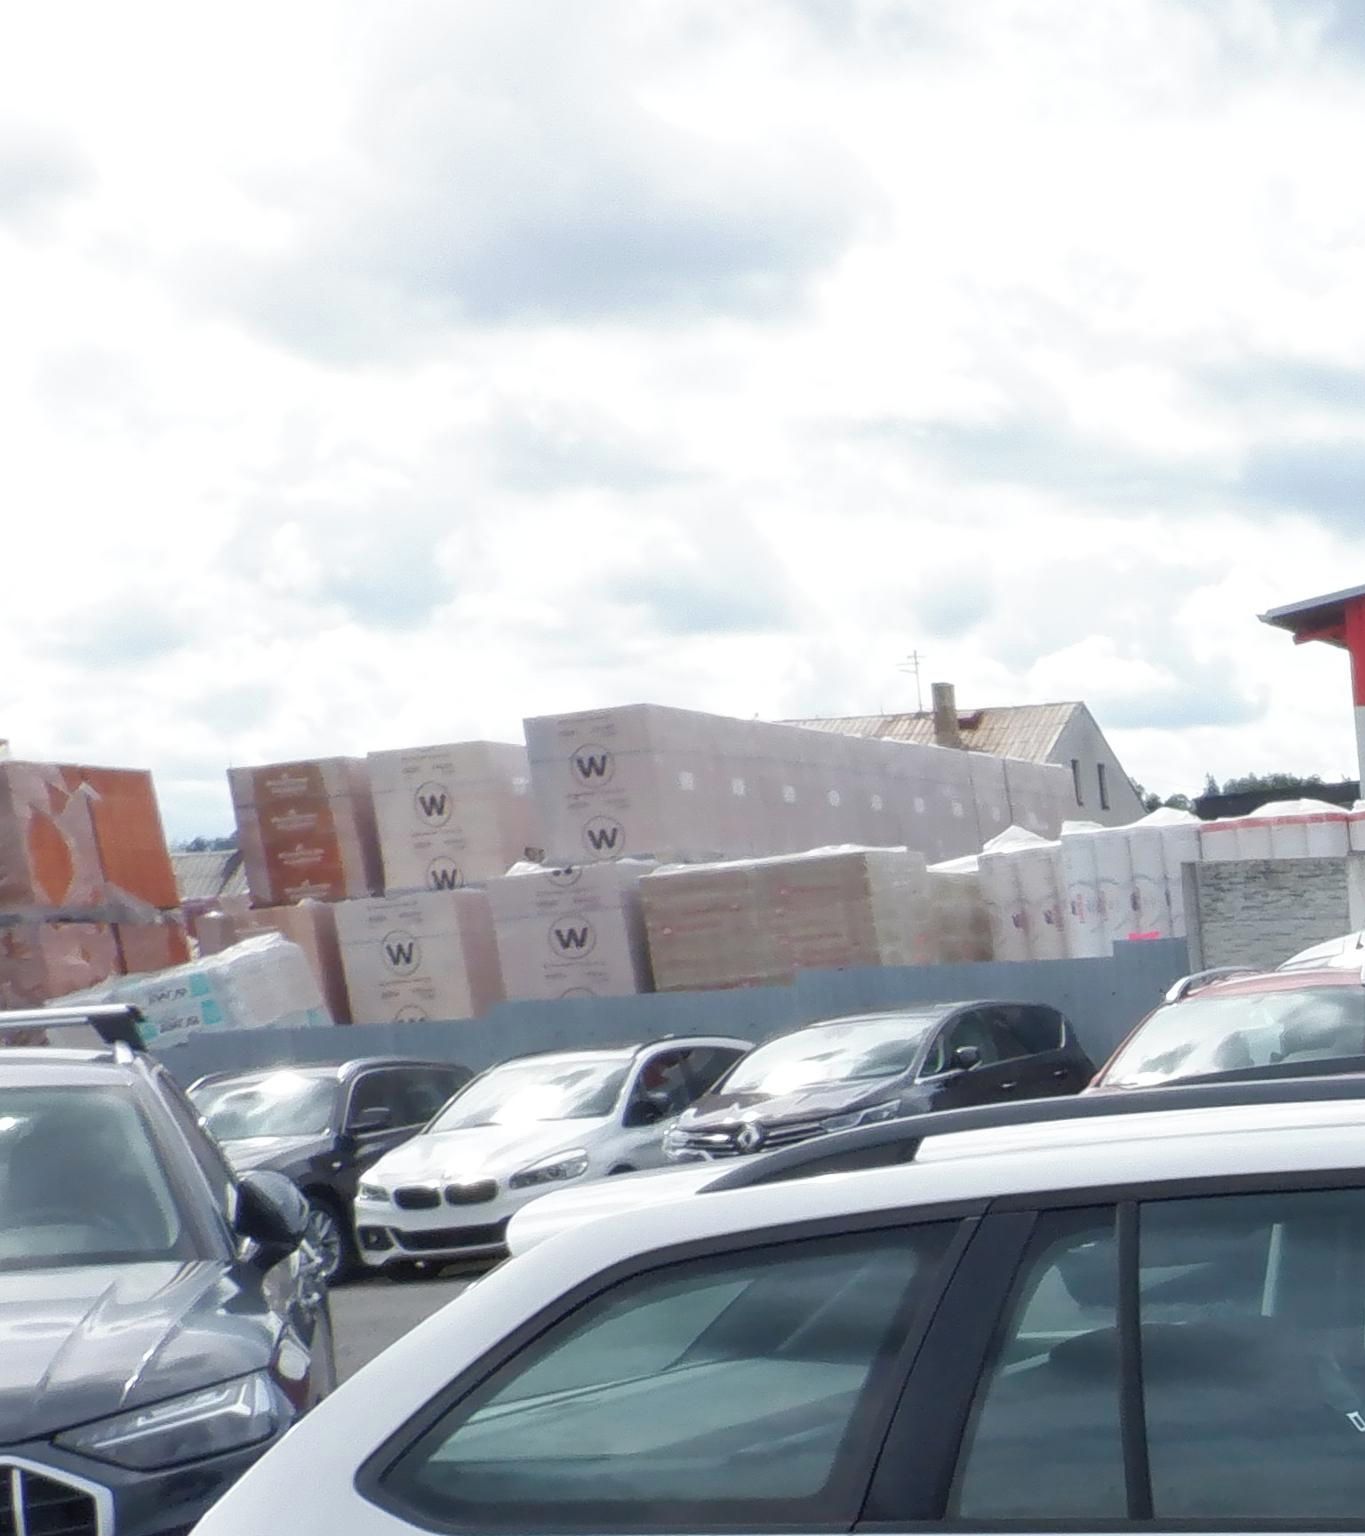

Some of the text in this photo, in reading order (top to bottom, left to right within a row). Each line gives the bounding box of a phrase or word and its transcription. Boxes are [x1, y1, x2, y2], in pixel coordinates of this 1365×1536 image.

[576, 754, 607, 778] W
[419, 794, 447, 816] W
[588, 827, 618, 850] W
[431, 868, 458, 890] W
[555, 927, 588, 949] W
[385, 942, 414, 966] W
